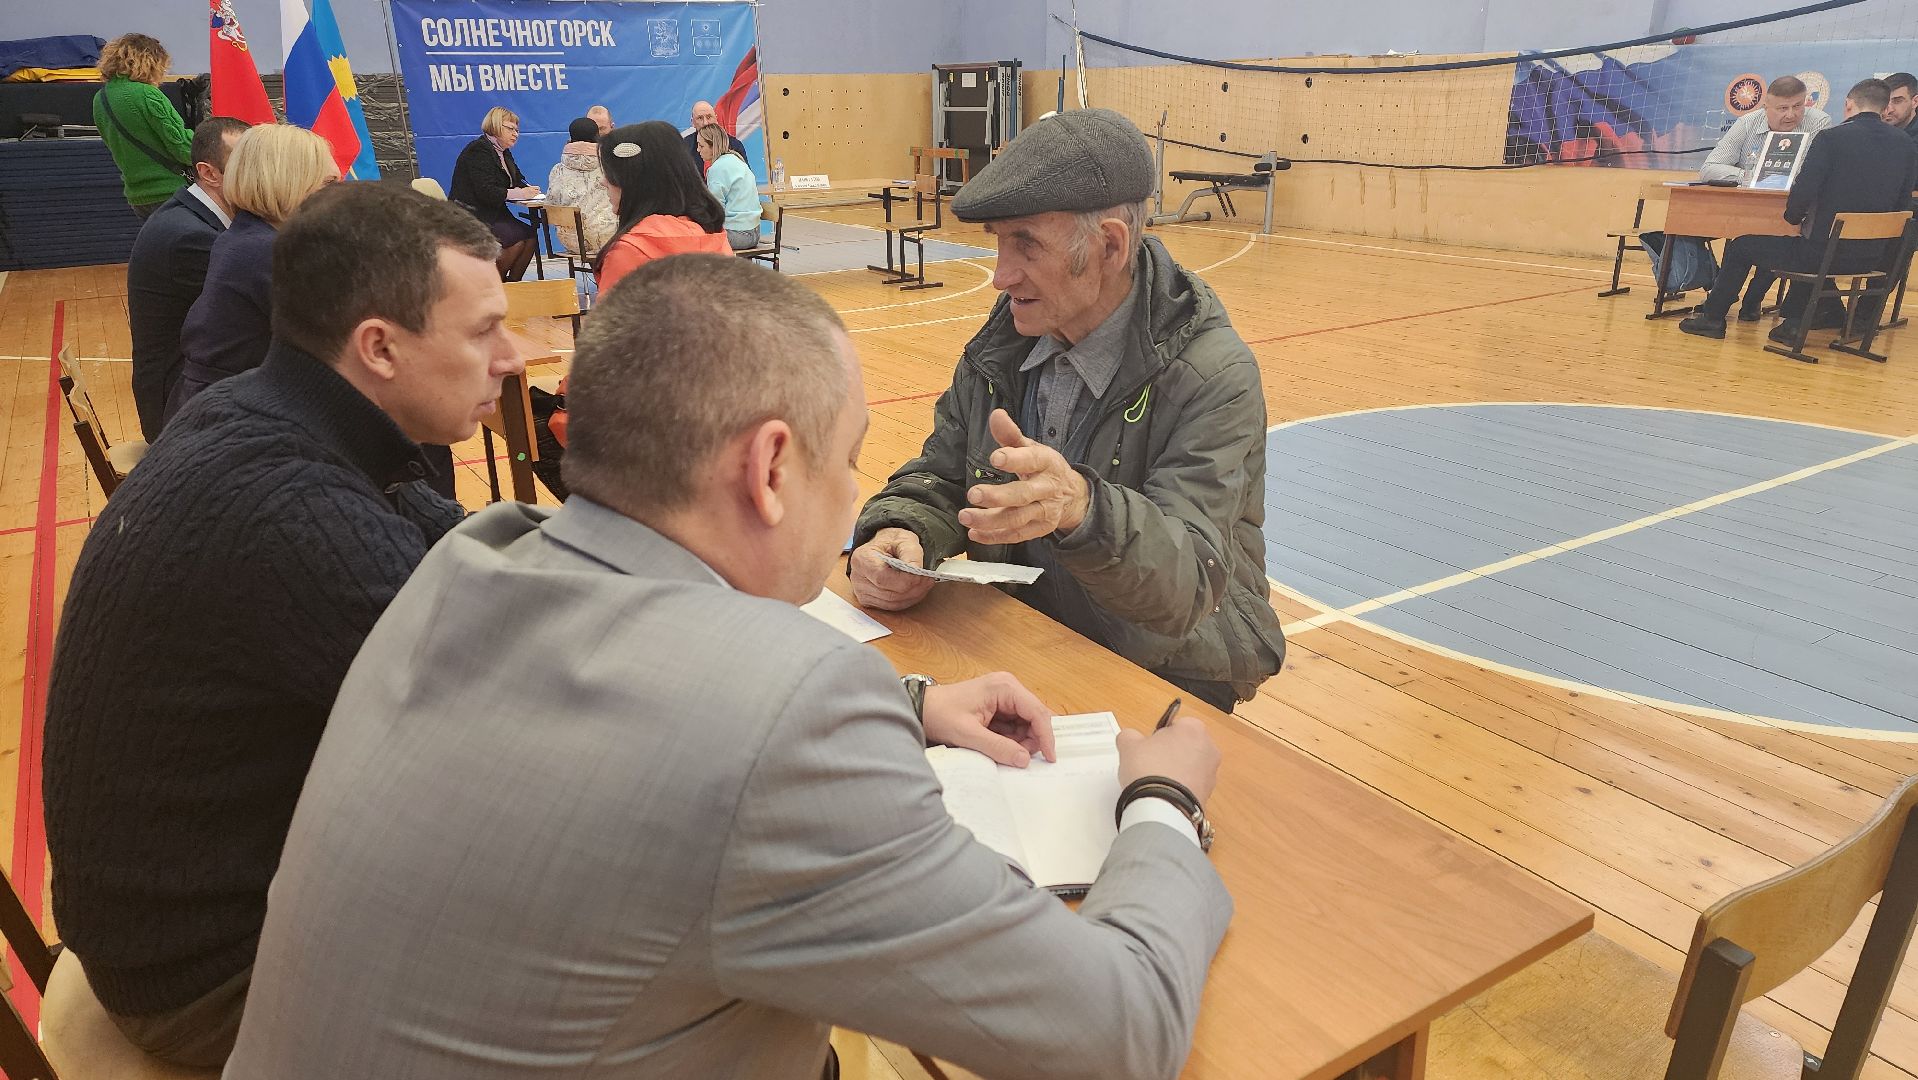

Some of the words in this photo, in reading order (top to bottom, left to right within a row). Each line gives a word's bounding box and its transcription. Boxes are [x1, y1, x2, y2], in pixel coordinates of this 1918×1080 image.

[421, 18, 616, 47] СОЛНЕЧНОГОРСК
[428, 64, 475, 92] МЫ
[478, 64, 568, 91] ВМЕСТЕ
